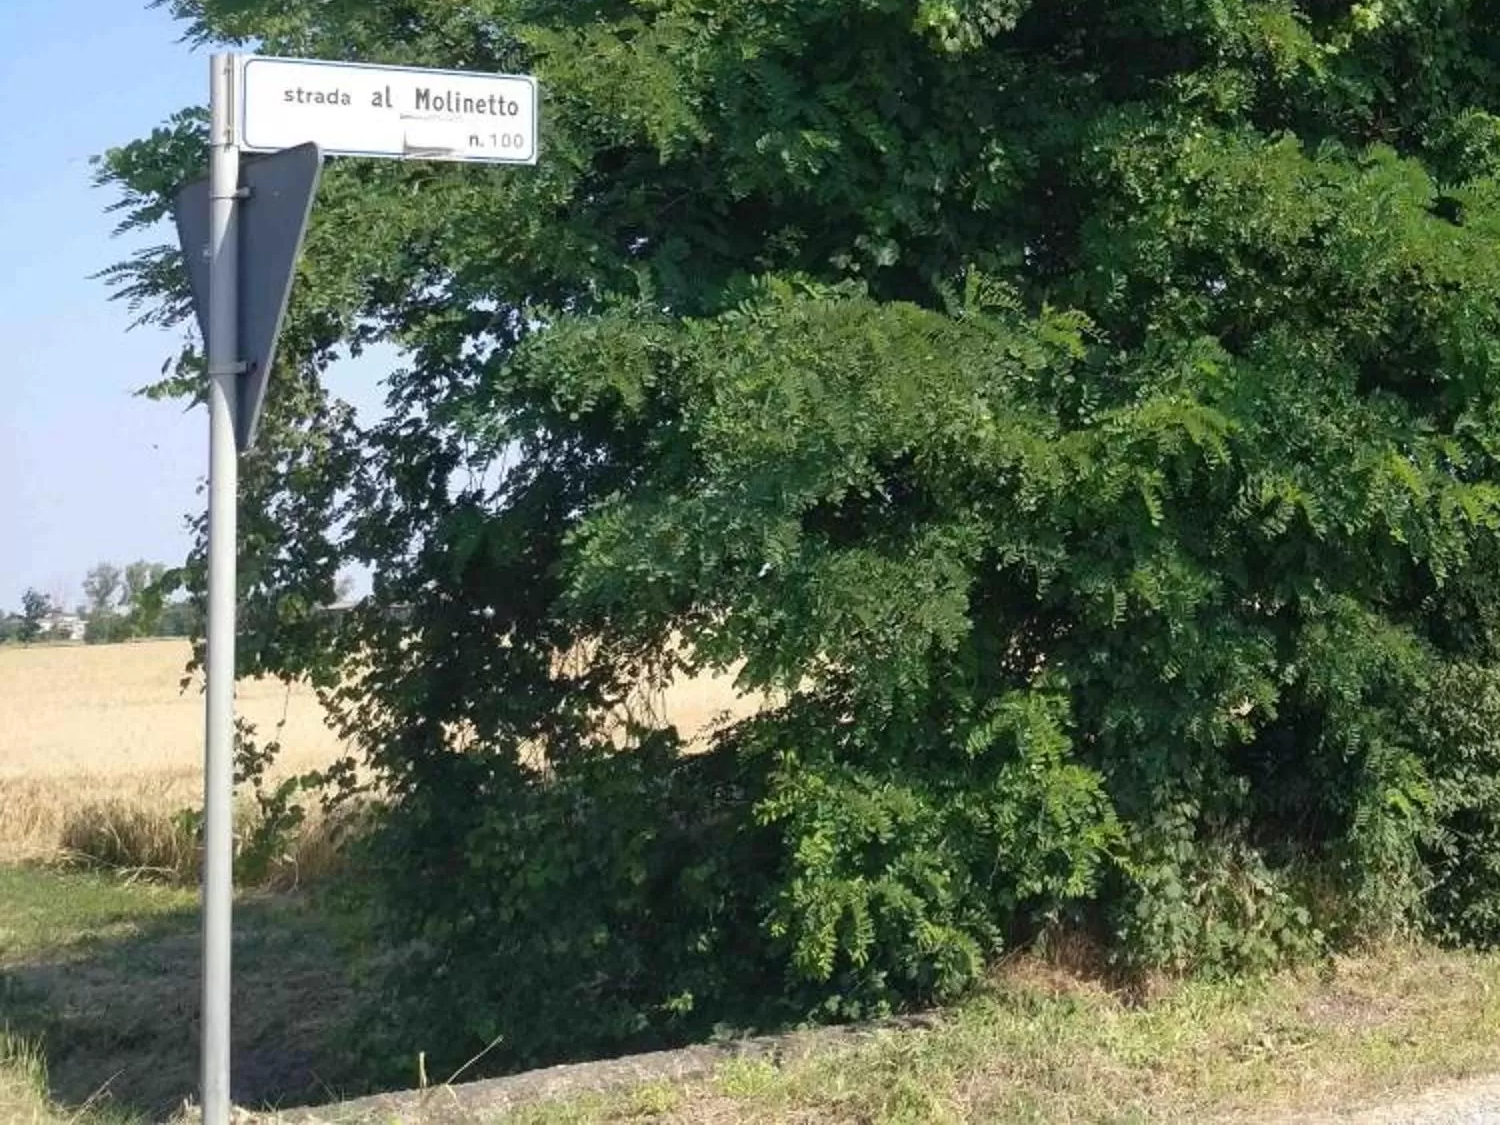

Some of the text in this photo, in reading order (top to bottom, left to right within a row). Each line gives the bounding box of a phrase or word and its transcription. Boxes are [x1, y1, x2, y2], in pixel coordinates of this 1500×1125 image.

[283, 85, 520, 117] strada al Molinetto
